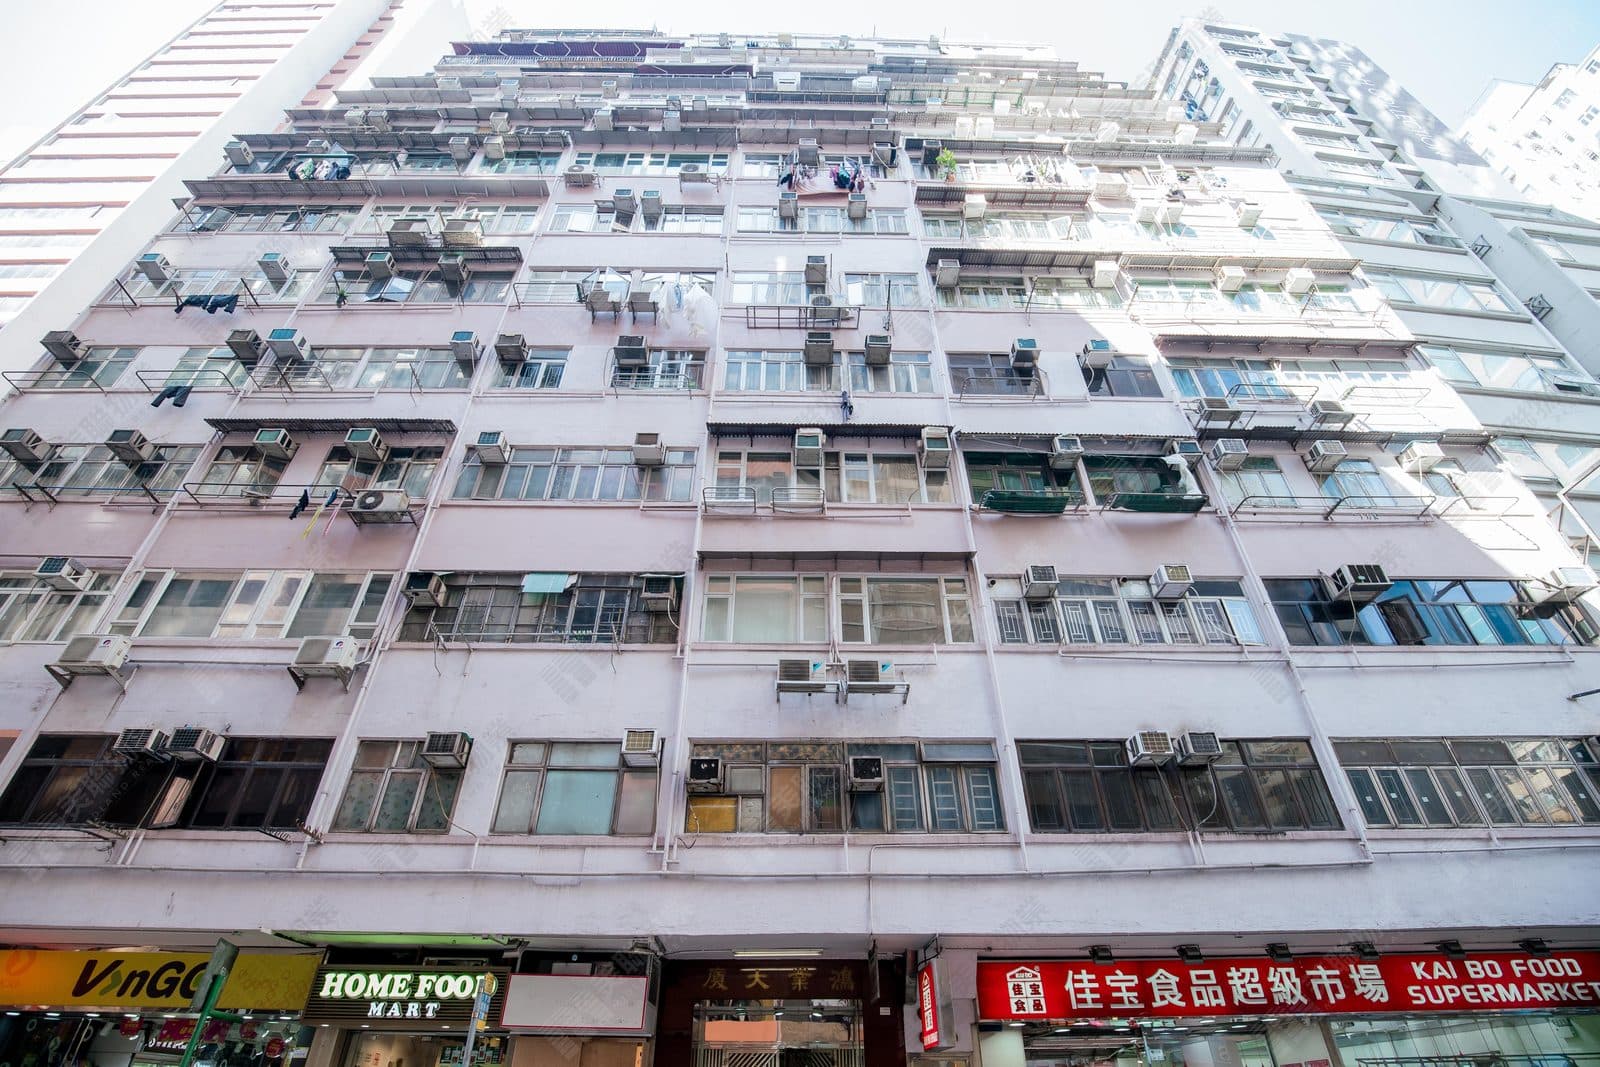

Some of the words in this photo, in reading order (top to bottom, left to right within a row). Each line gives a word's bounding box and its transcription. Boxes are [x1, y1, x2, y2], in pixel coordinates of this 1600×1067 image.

[1411, 961, 1458, 980] KAI
[1464, 959, 1503, 979] BO
[1510, 958, 1583, 978] FOOD
[319, 973, 413, 999] HOME
[1064, 964, 1390, 1010] 佳宝食品超級市場
[367, 1001, 440, 1018] MART
